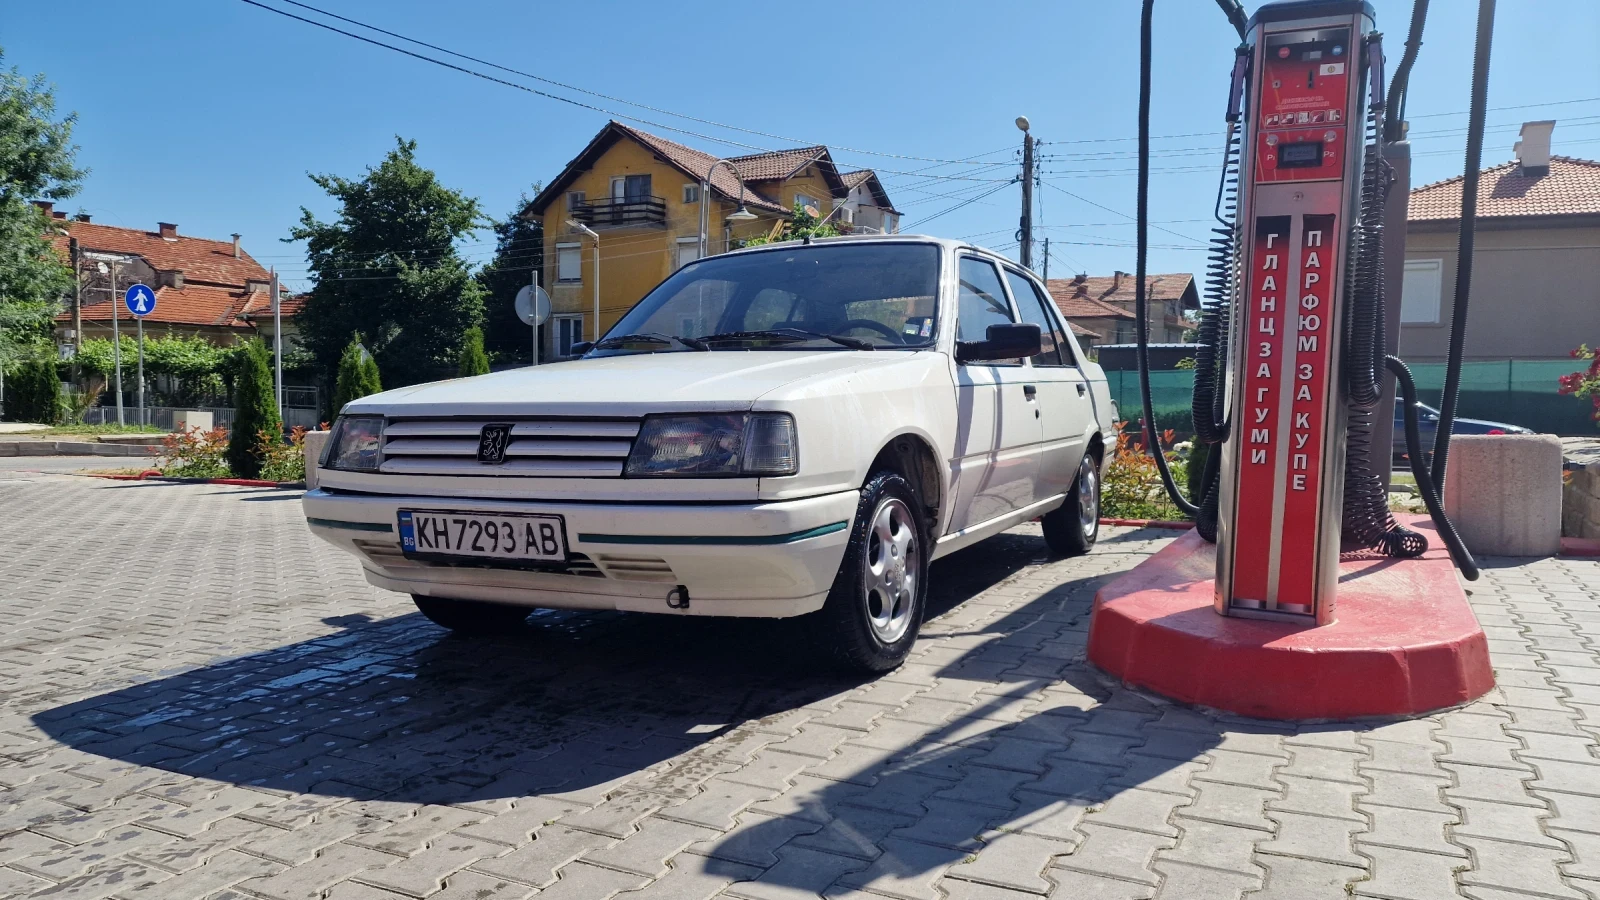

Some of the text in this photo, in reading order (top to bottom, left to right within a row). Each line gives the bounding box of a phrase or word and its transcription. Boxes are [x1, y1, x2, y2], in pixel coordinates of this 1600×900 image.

[1251, 233, 1278, 464] ГЛАНЦ ЗА ГУМИ
[1292, 230, 1322, 490] ПАРФЮМ ЗА КУПЕ
[404, 536, 415, 546] BG
